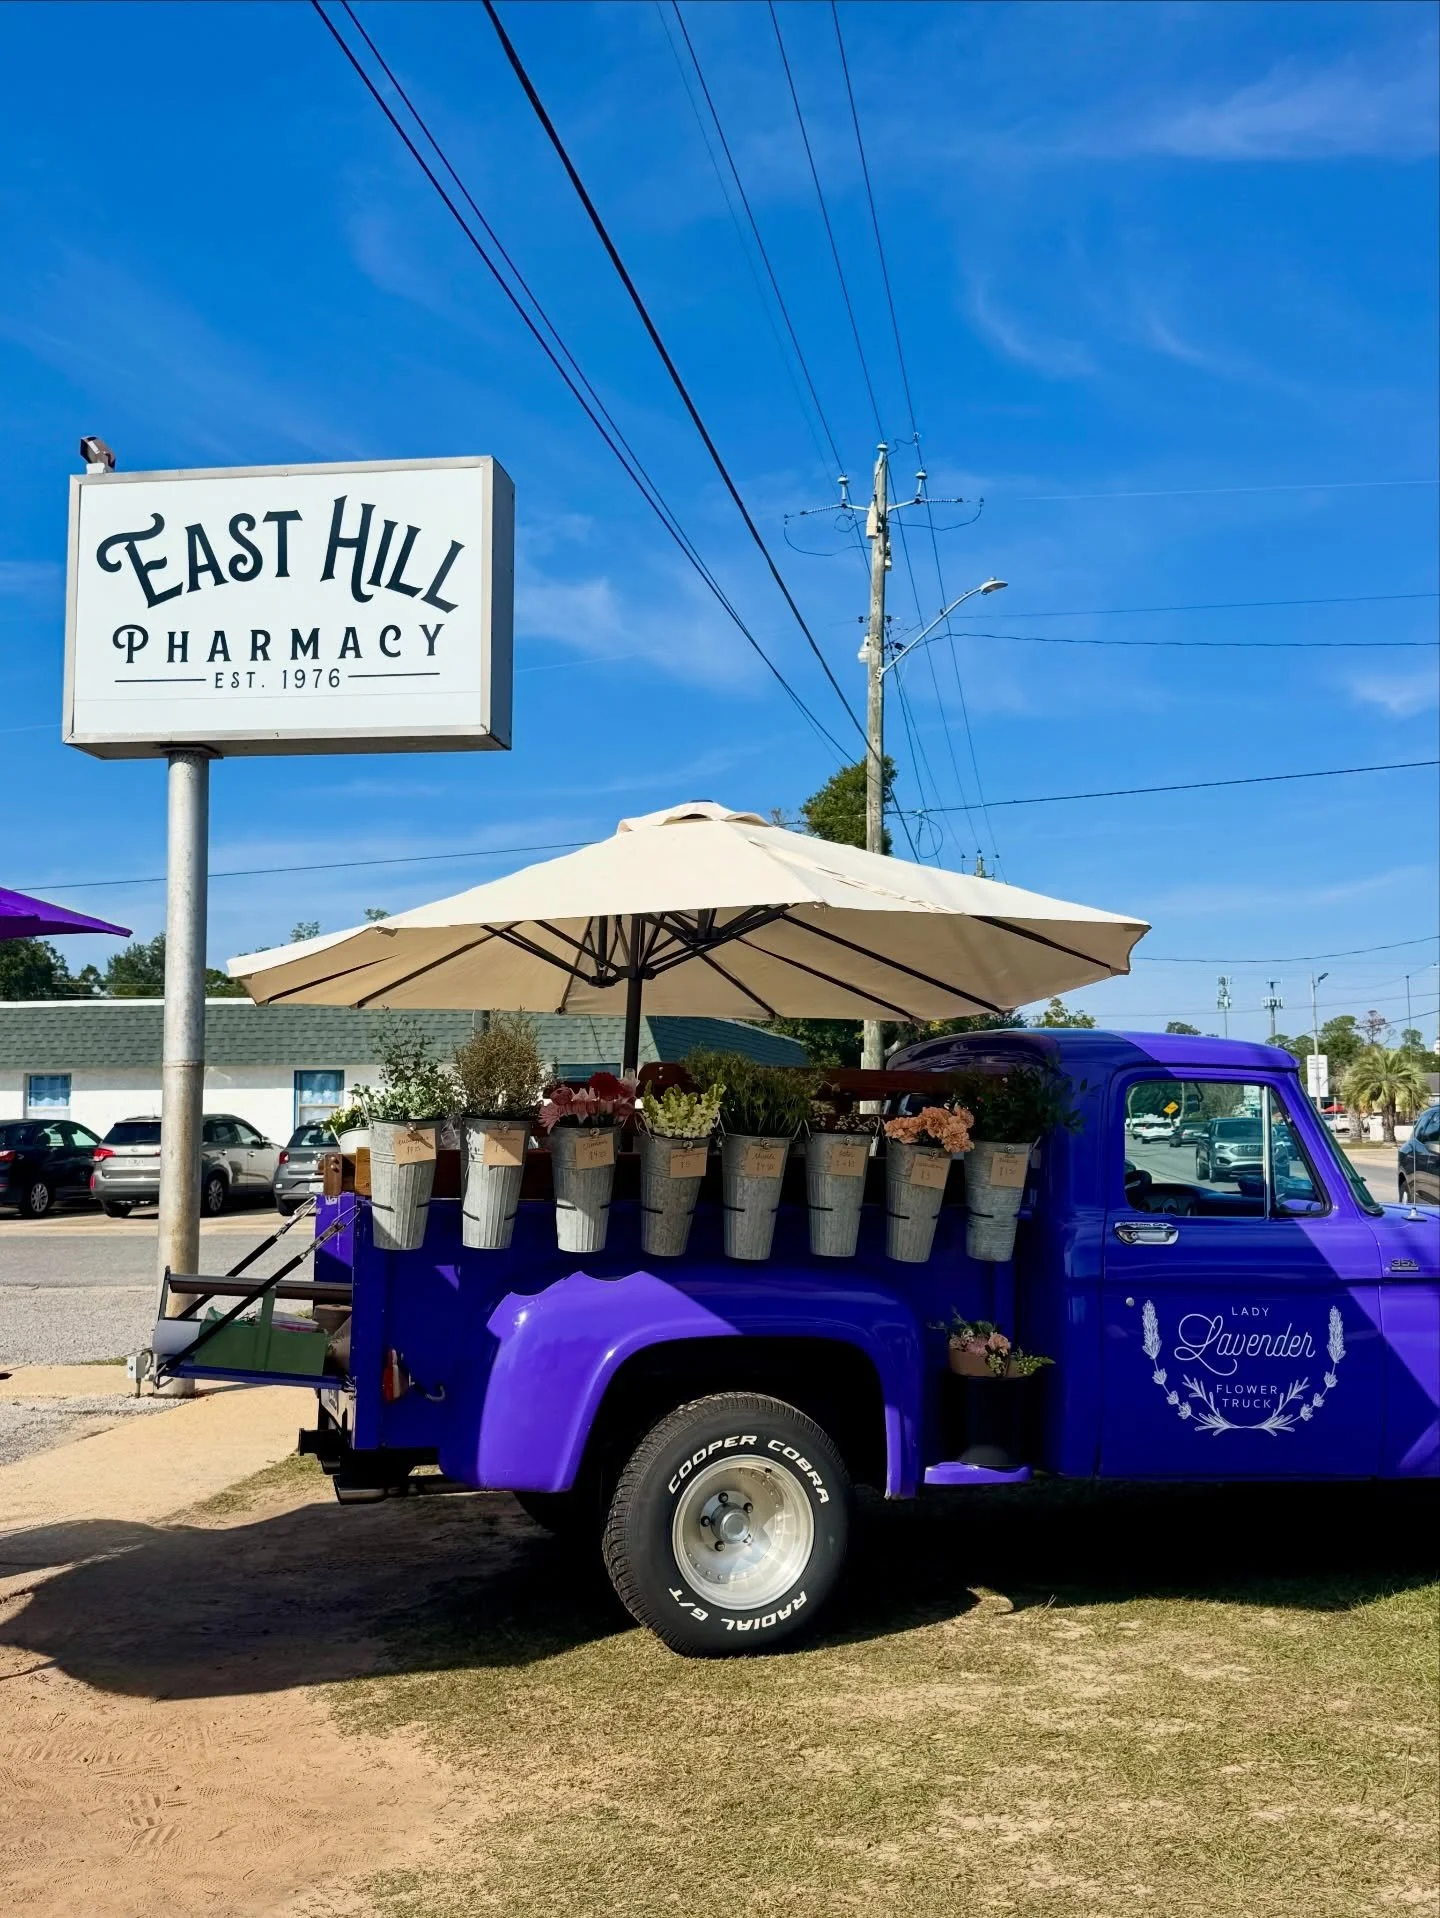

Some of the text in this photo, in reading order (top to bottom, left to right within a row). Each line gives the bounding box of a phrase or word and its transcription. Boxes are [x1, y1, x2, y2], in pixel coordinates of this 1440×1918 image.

[96, 495, 466, 614] EAST HILL
[112, 623, 445, 664] PHARMACY
[214, 668, 341, 690] EST. 1976
[1231, 1306, 1270, 1317] LADY
[1174, 1313, 1316, 1376] Lavender
[1216, 1384, 1278, 1395] FLOWER
[1222, 1398, 1272, 1409] TRUCK
[668, 1435, 830, 1504] COOPER COBRA
[668, 1587, 808, 1631] RADIAL G/T
